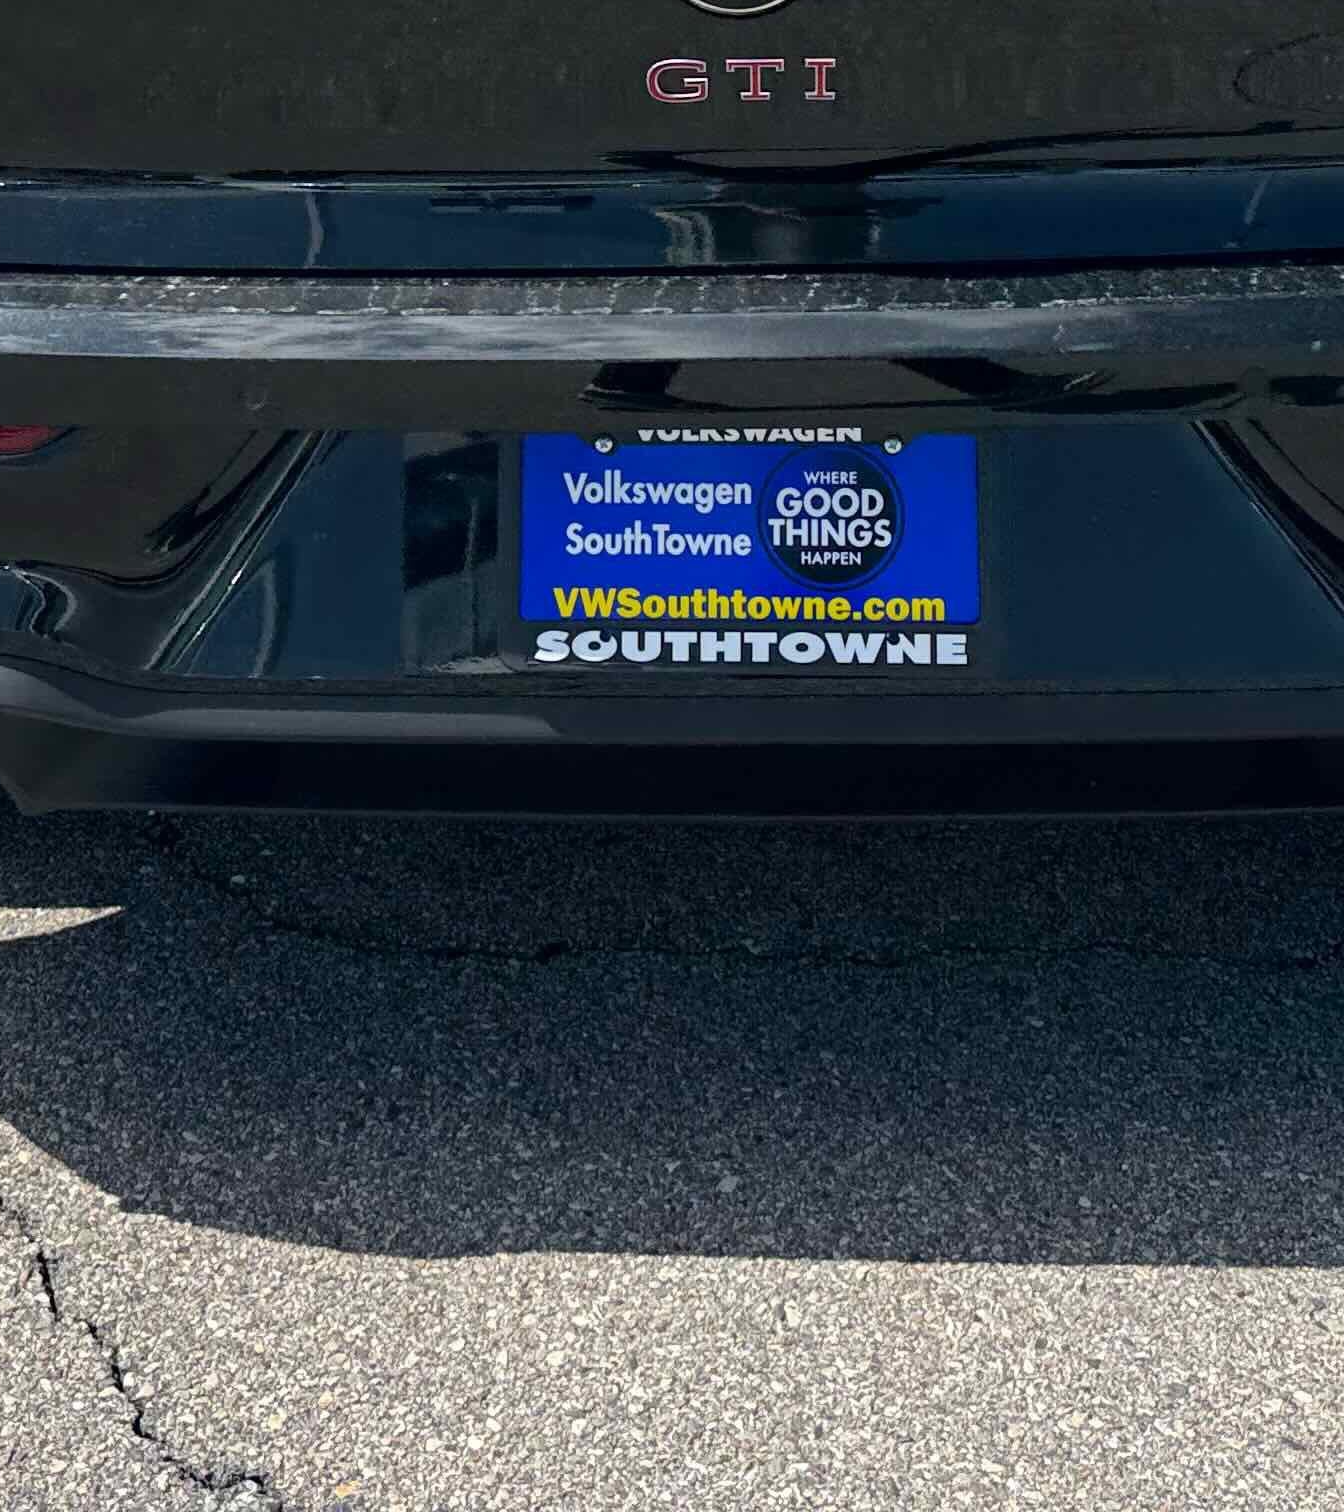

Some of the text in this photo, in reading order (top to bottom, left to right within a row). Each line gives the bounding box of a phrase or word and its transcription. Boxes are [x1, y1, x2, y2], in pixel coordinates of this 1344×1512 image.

[646, 58, 836, 103] GTI
[563, 470, 753, 513] Volkswagen
[803, 471, 858, 486] WHERE
[775, 487, 885, 519] GOOD
[564, 522, 753, 557] SouthTowne
[767, 518, 893, 549] THINGS
[800, 550, 862, 566] HAPPEN
[552, 587, 946, 622] VWSouthtowne.com
[533, 630, 969, 666] SOUTHTOWNE
